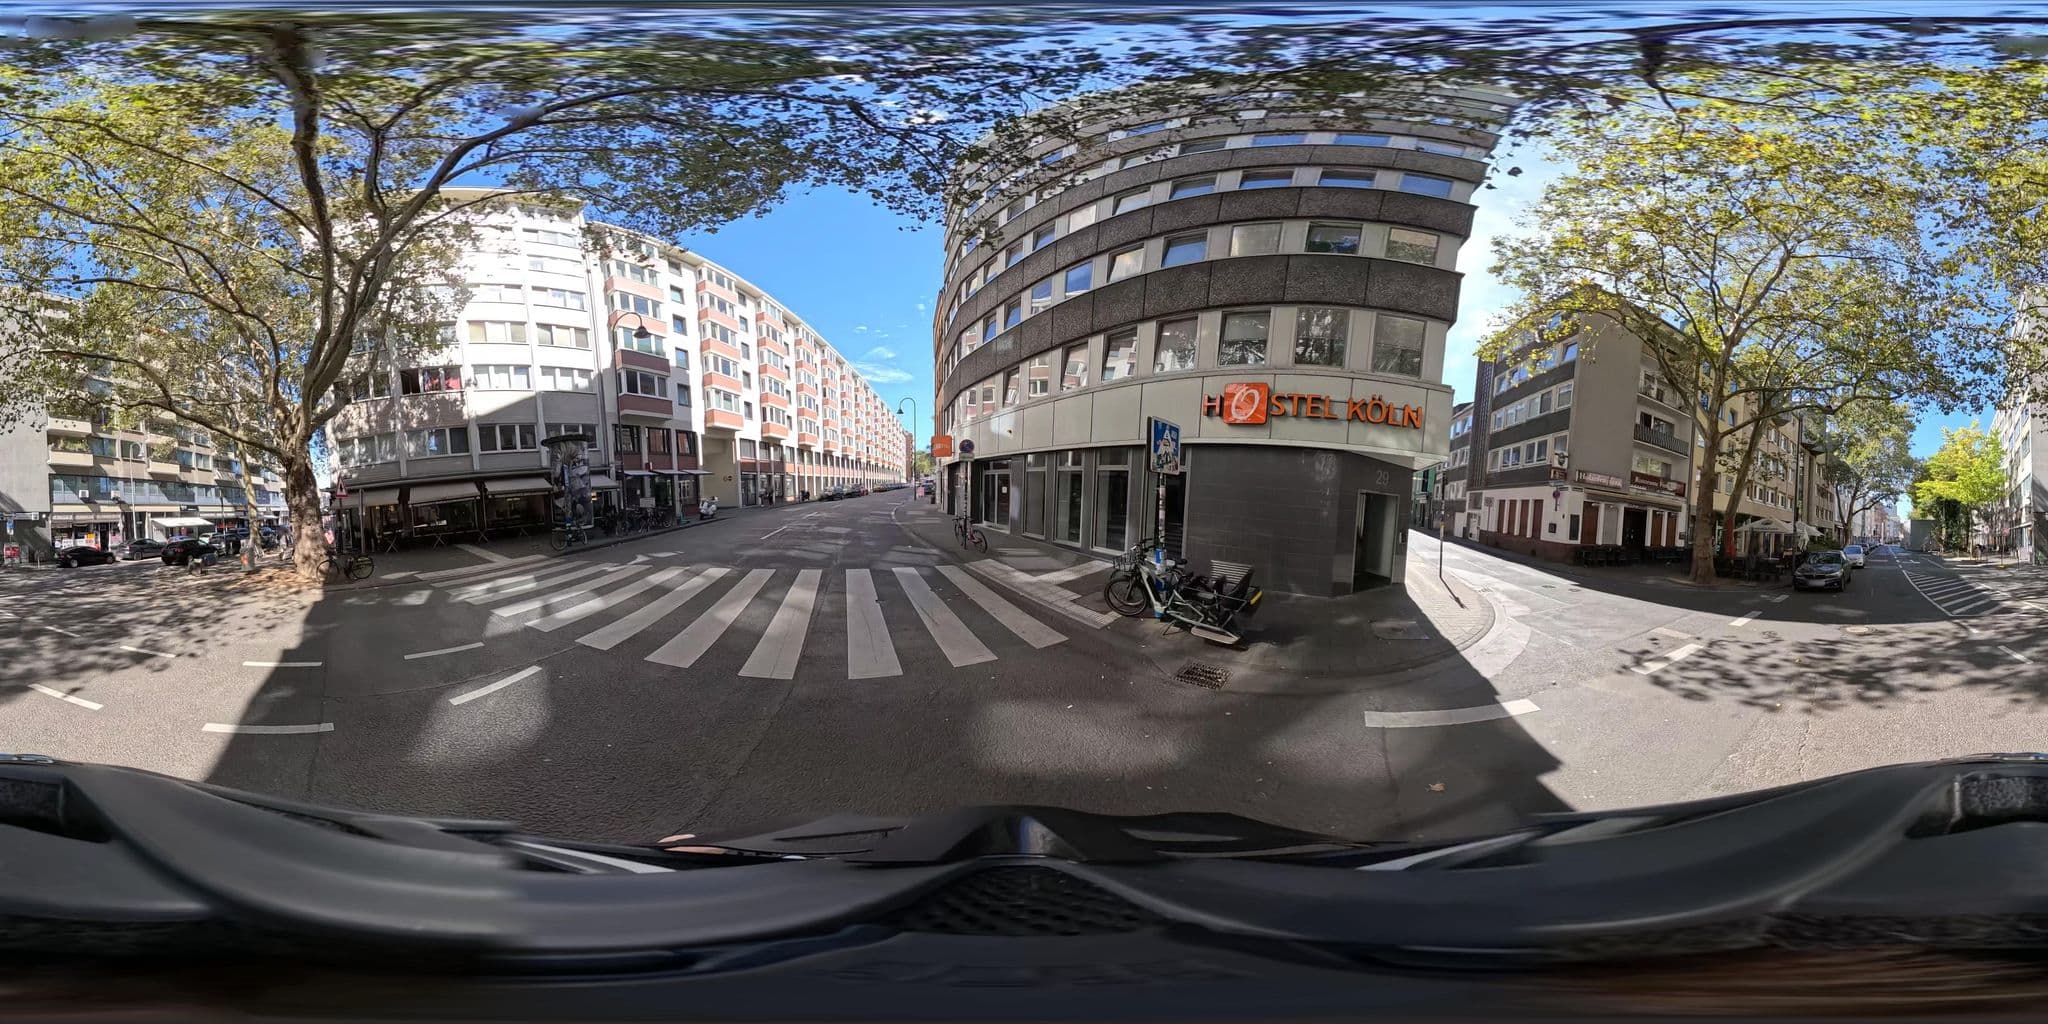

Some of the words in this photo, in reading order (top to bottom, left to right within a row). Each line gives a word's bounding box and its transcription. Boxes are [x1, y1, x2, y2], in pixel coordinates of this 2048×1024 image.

[1203, 386, 1338, 422] HOSTEL
[1347, 394, 1423, 429] KÖLN
[1375, 470, 1389, 485] 29
